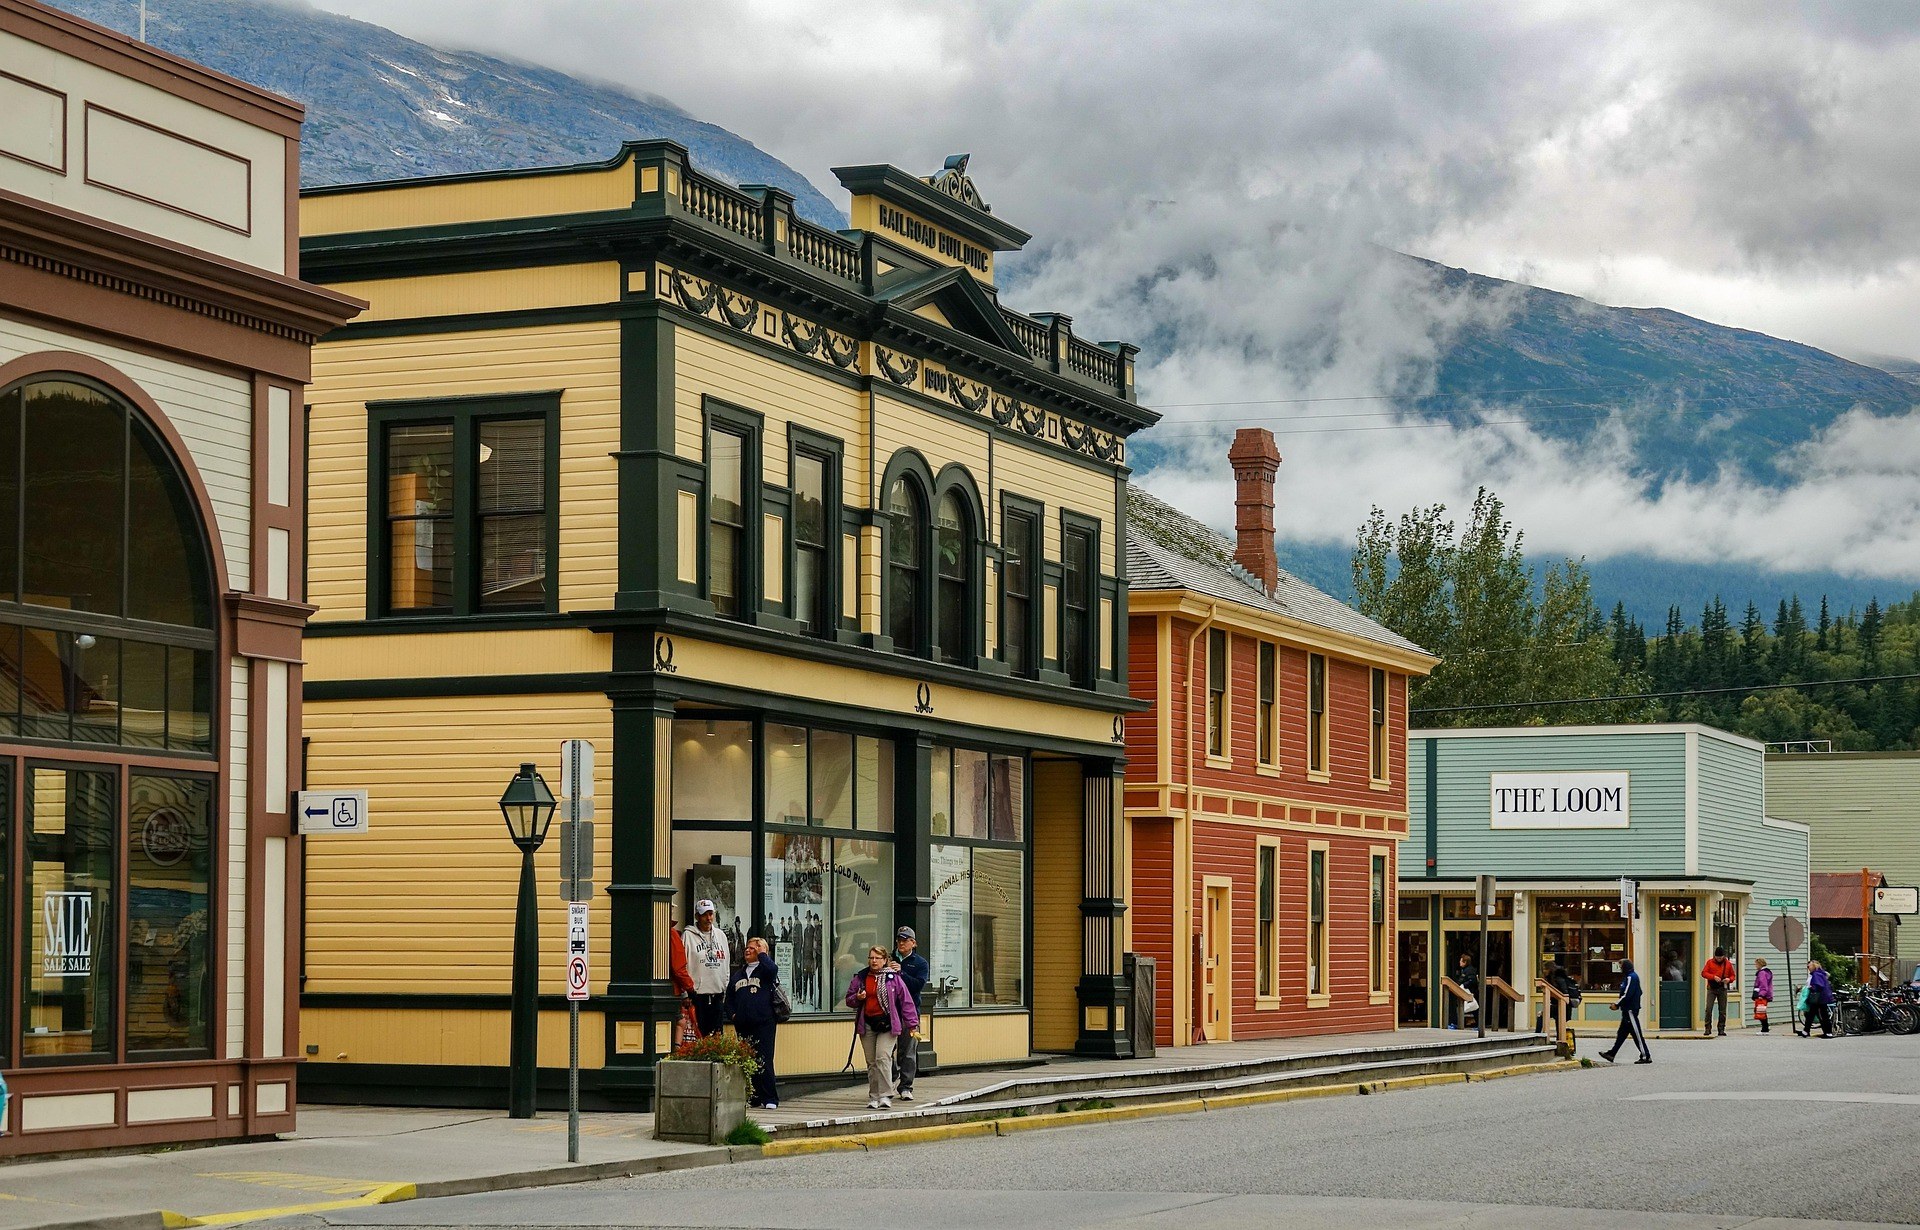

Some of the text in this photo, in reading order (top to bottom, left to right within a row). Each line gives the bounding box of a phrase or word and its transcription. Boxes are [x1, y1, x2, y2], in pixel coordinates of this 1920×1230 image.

[880, 204, 988, 272] RAILROAD BUILDING
[925, 367, 946, 393] 1900
[1495, 787, 1622, 813] THE LOOM
[793, 862, 829, 890] KLONDIKE
[834, 862, 851, 878] GOLD
[853, 872, 870, 896] RUSH
[932, 874, 959, 900] NATIONAL
[44, 896, 92, 956] SALE
[44, 957, 91, 971] SALE SALE
